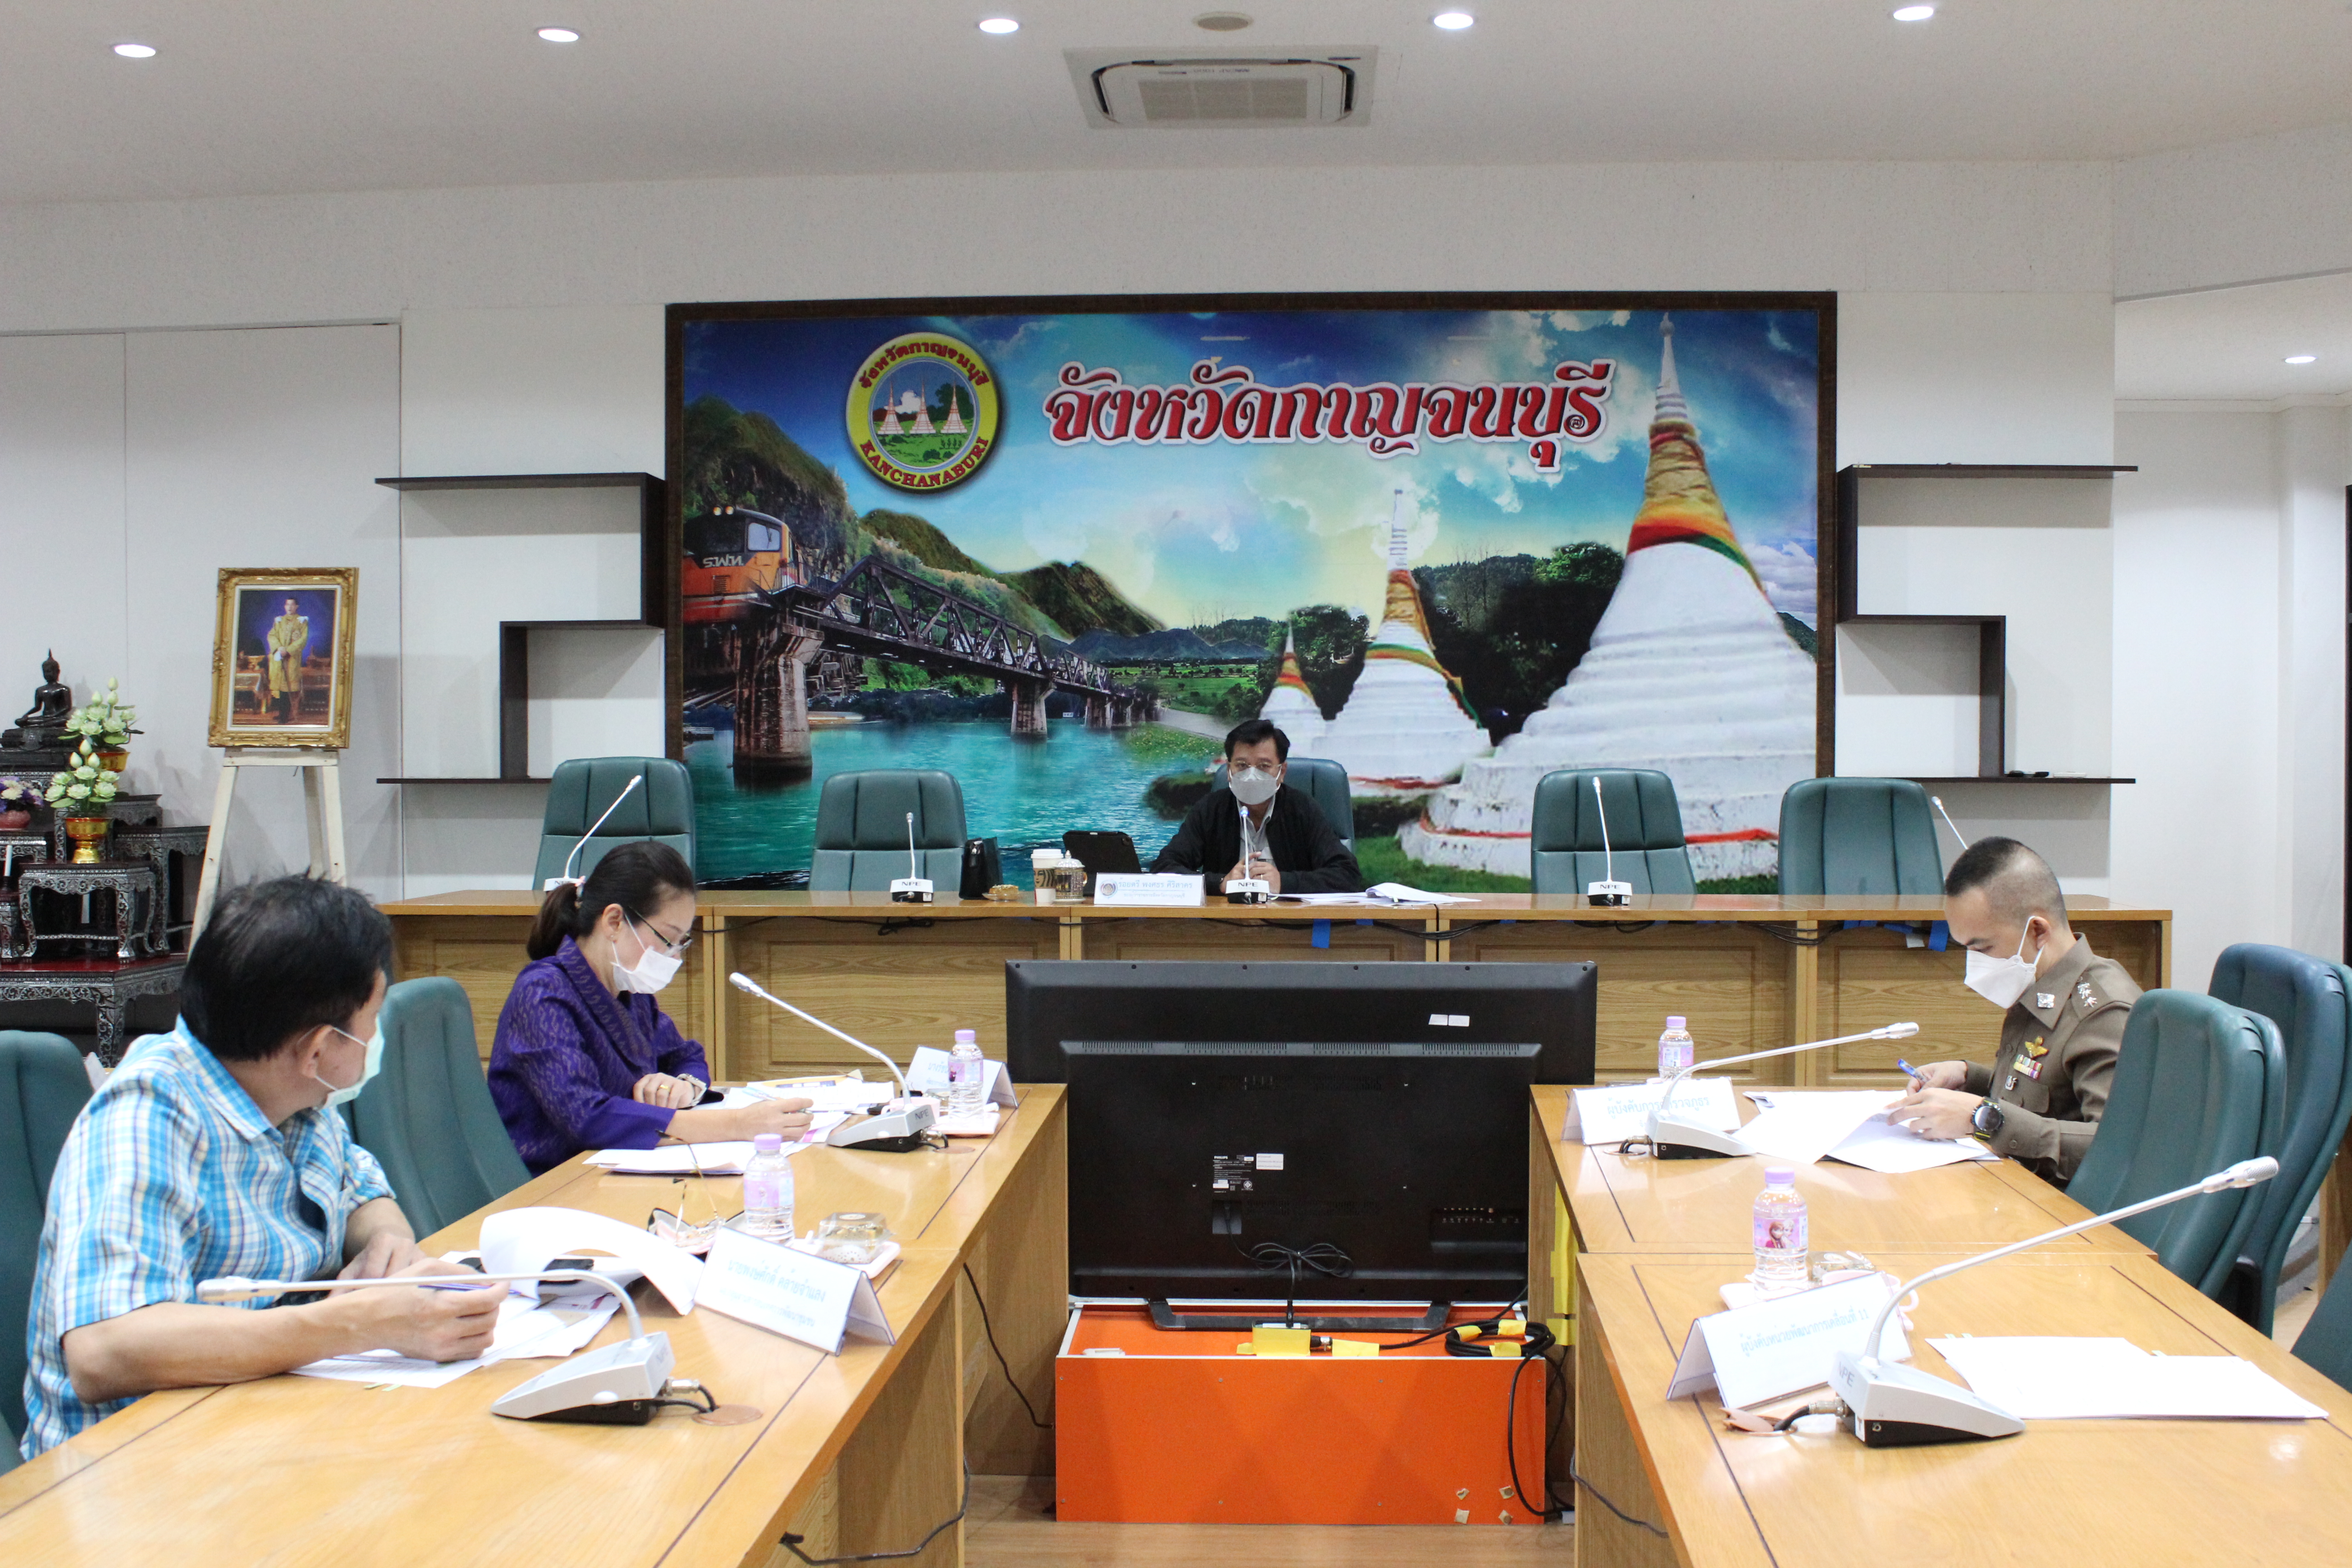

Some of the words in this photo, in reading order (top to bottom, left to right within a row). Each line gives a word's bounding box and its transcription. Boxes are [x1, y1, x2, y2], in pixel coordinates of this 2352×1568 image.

[859, 342, 989, 389] จังหวัดกาญจนบุรี
[1044, 360, 1612, 468] จังหวัดกาญจนบุรี
[859, 436, 989, 487] KANCHANABURI
[1118, 877, 1140, 887] ร้อยตรี
[915, 1109, 929, 1120] NPE
[1740, 1305, 1857, 1357] ผู้บังคับหน่วยพัฒนาการเคลื่อนที่
[1858, 1308, 1870, 1320] 11
